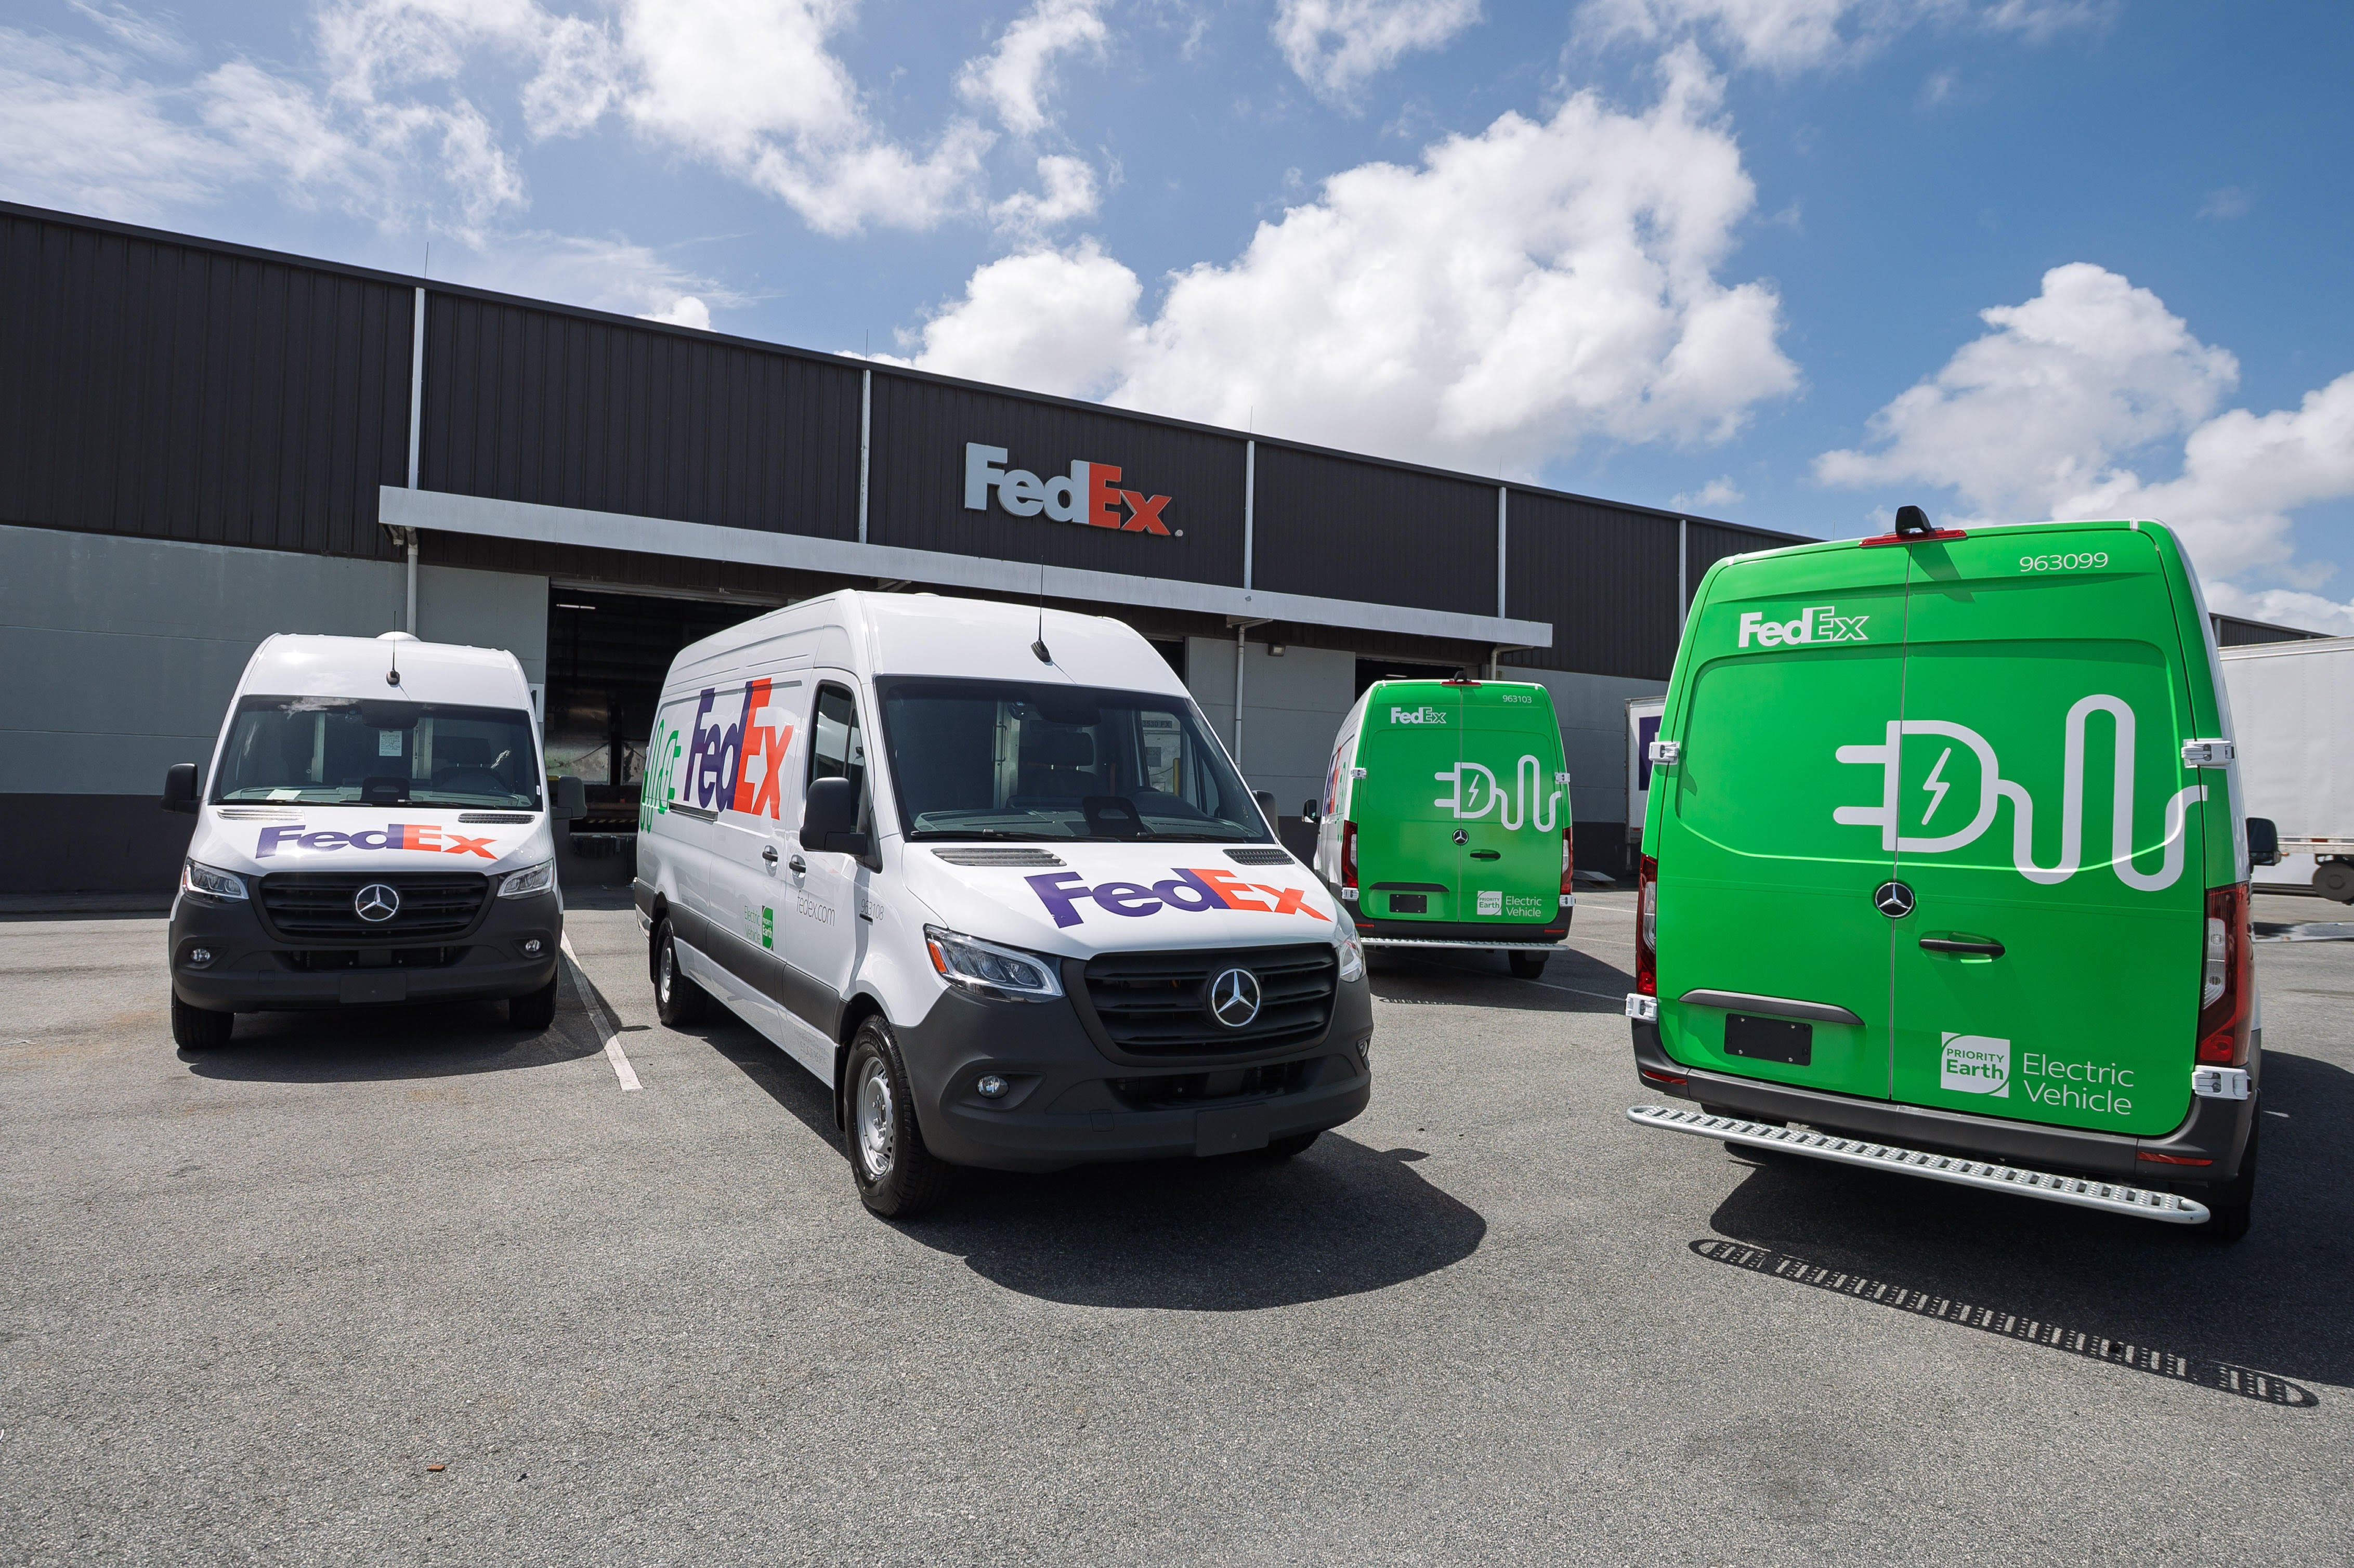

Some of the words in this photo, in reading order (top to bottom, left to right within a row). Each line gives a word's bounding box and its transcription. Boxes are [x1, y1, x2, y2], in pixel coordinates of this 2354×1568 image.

[2019, 552, 2109, 572] 963099
[1738, 606, 1869, 648] FedEx
[1502, 695, 1532, 704] 963103
[1391, 707, 1446, 724] FedEx
[683, 677, 794, 820] FedEx
[255, 824, 499, 860] FedEx
[796, 890, 835, 926] fedex.com
[860, 898, 884, 920] 963108
[1024, 868, 1333, 929] FedEx
[1506, 896, 1542, 906] Electric
[744, 905, 761, 926] Electric
[1506, 907, 1541, 917] Vehicle
[1946, 1048, 2004, 1063] PRIORITY
[1946, 1059, 2004, 1080] Earth
[2023, 1053, 2134, 1087] Electric
[2024, 1080, 2132, 1115] Vehicle
